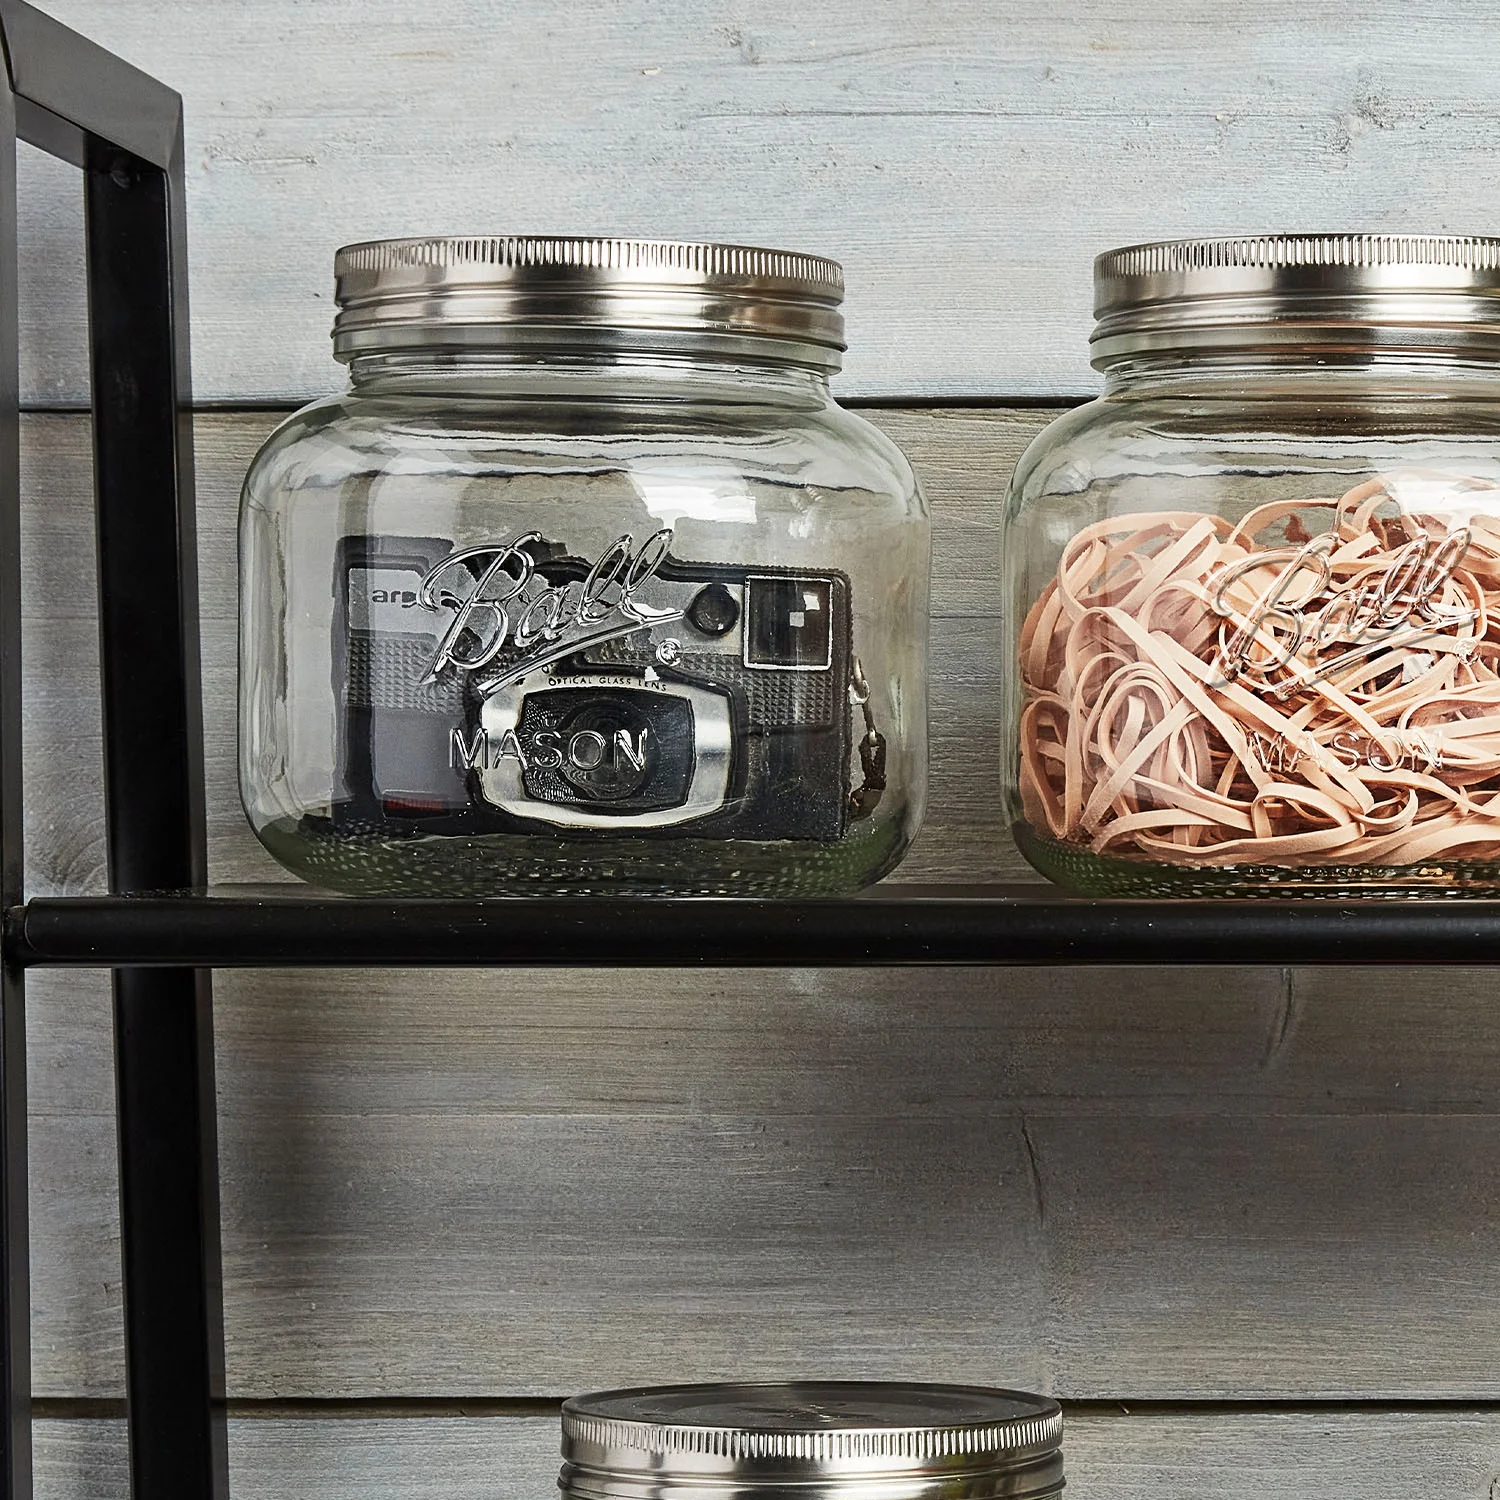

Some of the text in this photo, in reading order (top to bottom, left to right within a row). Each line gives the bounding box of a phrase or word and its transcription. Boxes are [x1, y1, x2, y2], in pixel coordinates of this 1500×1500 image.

[416, 528, 684, 700] Ball
[599, 677, 631, 686] GLASS
[638, 680, 667, 692] LENS
[448, 727, 648, 772] MASON
[1248, 728, 1445, 773] MASON
